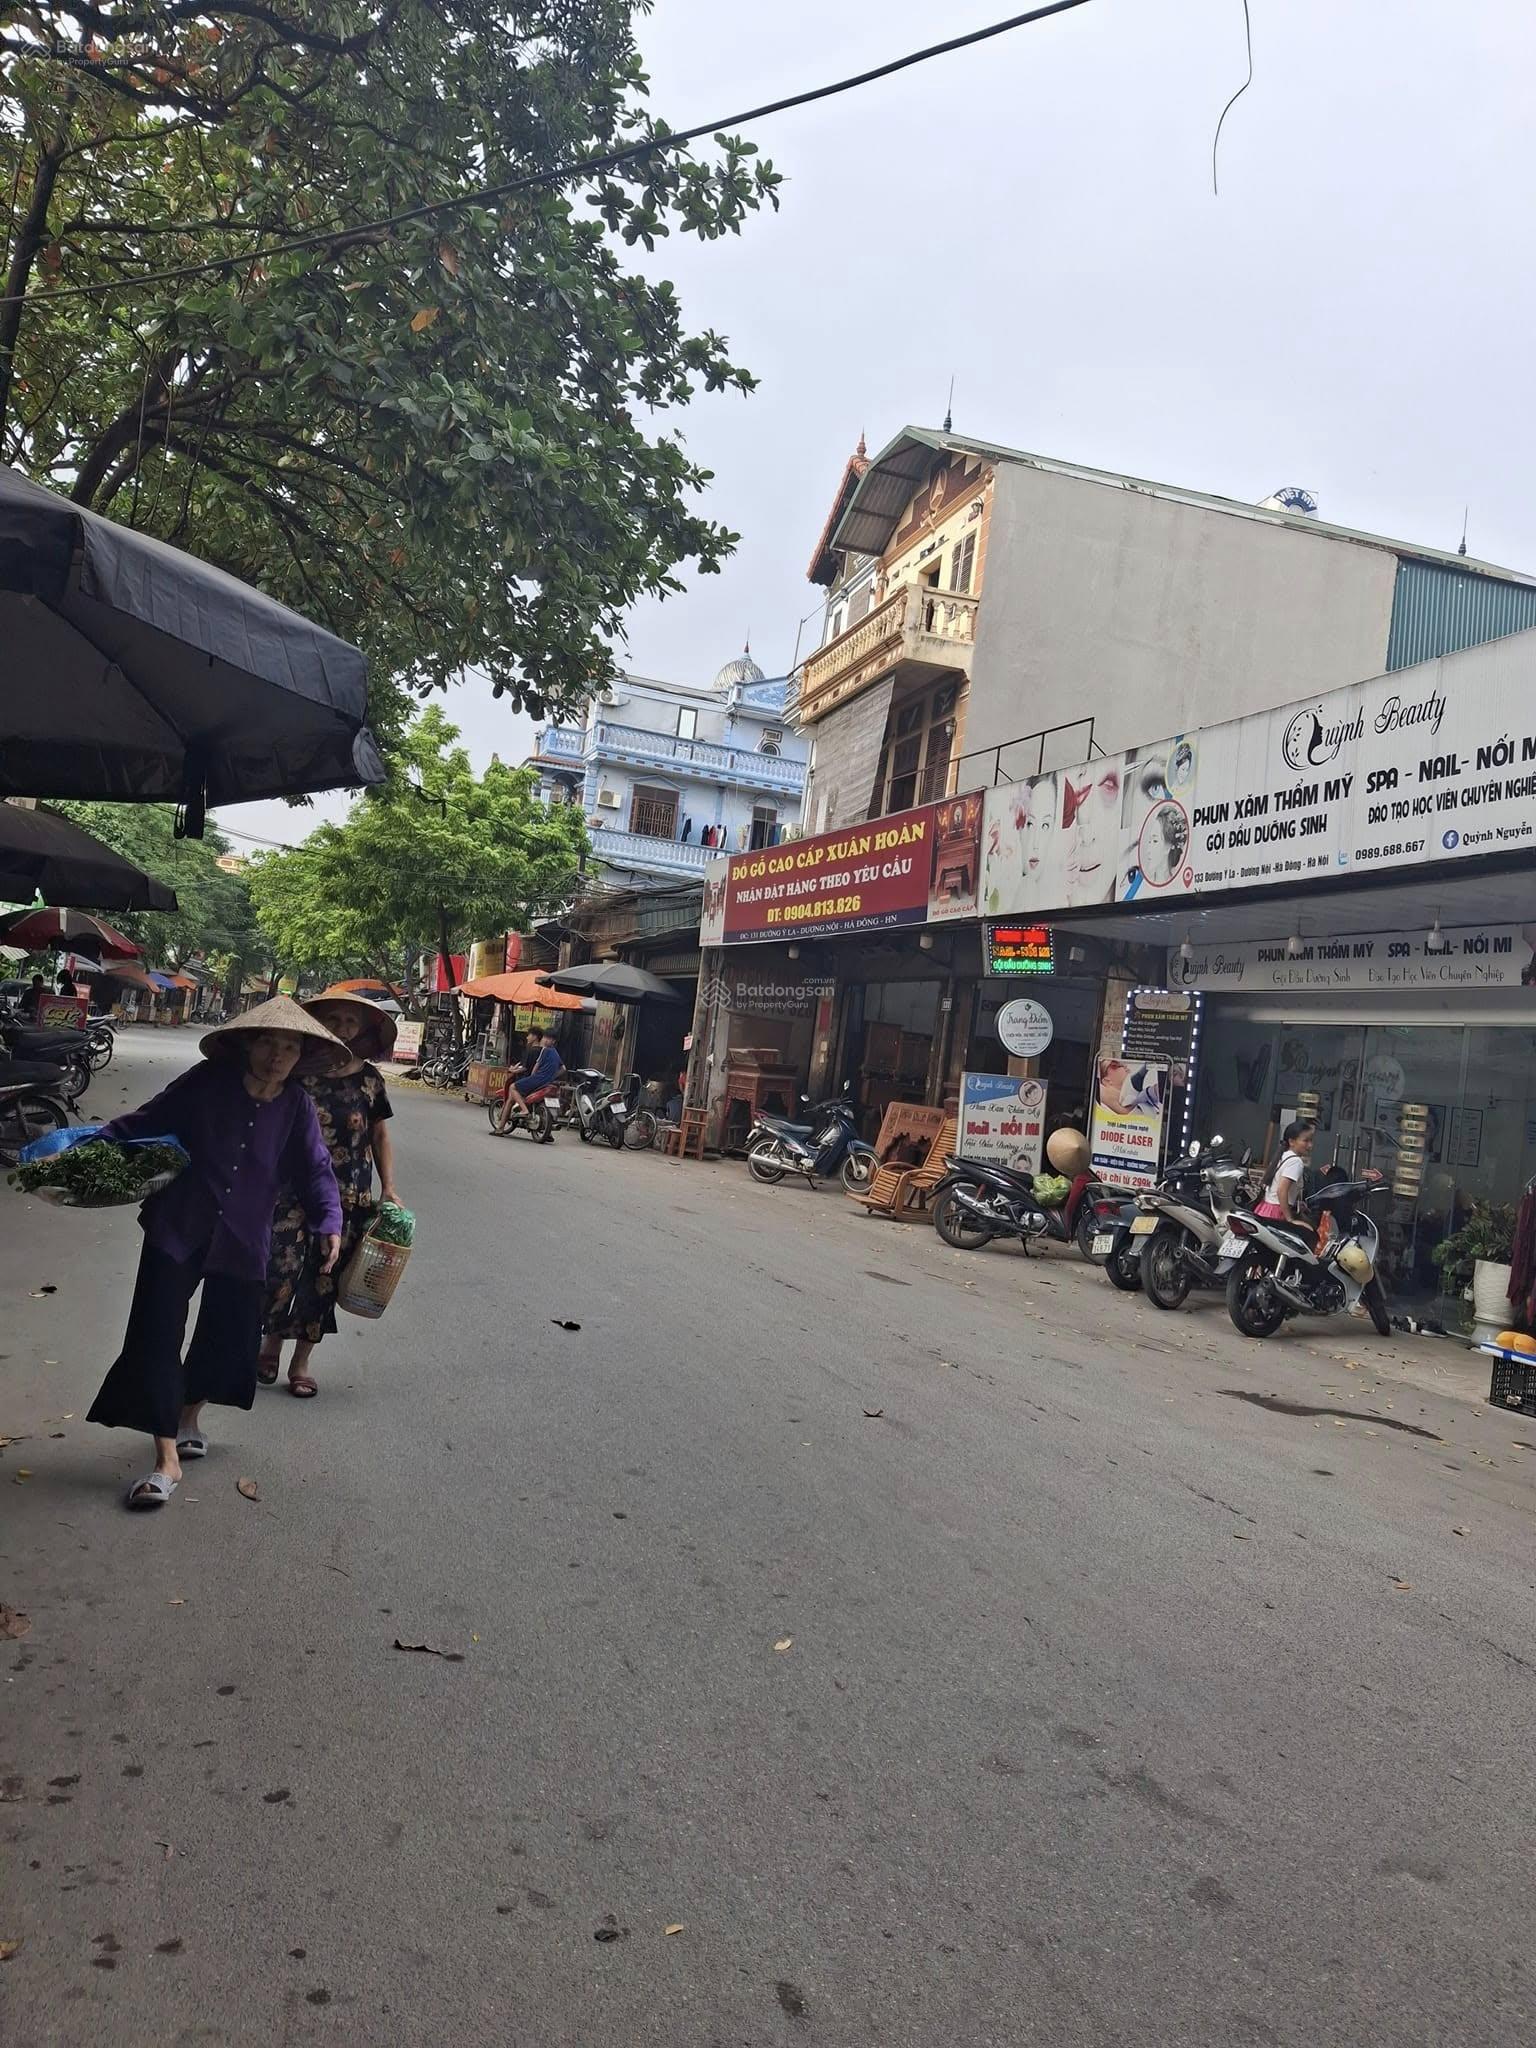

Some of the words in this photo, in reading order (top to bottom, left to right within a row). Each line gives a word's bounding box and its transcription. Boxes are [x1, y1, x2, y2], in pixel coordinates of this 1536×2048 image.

[1374, 689, 1447, 735] Beauty
[1366, 768, 1399, 794] SPA
[1476, 733, 1516, 770] NỐI
[1193, 802, 1229, 827] PHUN
[1234, 794, 1269, 820] XĂM
[1274, 778, 1319, 812] THẨM
[1324, 772, 1354, 802] MỸ
[1368, 802, 1388, 824] ĐÀO
[1391, 800, 1409, 823] TẠO
[1412, 795, 1433, 819] HỌC
[1436, 787, 1458, 812] VIÊN
[1461, 779, 1502, 807] CHUYÊN
[1206, 829, 1225, 855] GỘI
[1228, 823, 1251, 848] ĐẦU
[1300, 813, 1328, 836] SINH
[1462, 830, 1493, 847] Quỳnh
[1496, 821, 1533, 841] Nguyễn
[732, 859, 749, 881] ĐỒ
[749, 855, 766, 878] GỖ
[768, 855, 794, 874] CAO
[796, 845, 823, 870] CẤP
[826, 834, 871, 862] XUÂN
[874, 822, 926, 849] HOÀN
[1355, 839, 1426, 861] 0989.688.667
[736, 885, 762, 904] NHẬN
[764, 884, 785, 900] ĐẶT
[786, 878, 817, 896] HÀNG
[819, 872, 850, 891] THEO
[853, 865, 879, 886] YÊU
[882, 854, 913, 879] CẦU
[1194, 873, 1204, 884] 133
[1228, 869, 1236, 879] La
[783, 895, 862, 922] 0904.813.826
[826, 923, 839, 933] NỘI
[844, 919, 855, 929] HÀ
[855, 916, 879, 928] ĐÔNG
[884, 914, 898, 924] HN
[1257, 948, 1285, 962] PHUN
[1317, 939, 1350, 960] THẨM
[1353, 940, 1374, 959] MỸ
[1387, 942, 1411, 958] SPA
[1463, 932, 1489, 954] NỐI
[1493, 936, 1512, 953] MI
[1212, 955, 1245, 981] Beauty
[1333, 967, 1351, 984] Sinh
[1101, 1131, 1125, 1144] DIODE
[1127, 1134, 1153, 1147] LASER
[1132, 1177, 1152, 1187] 299k
